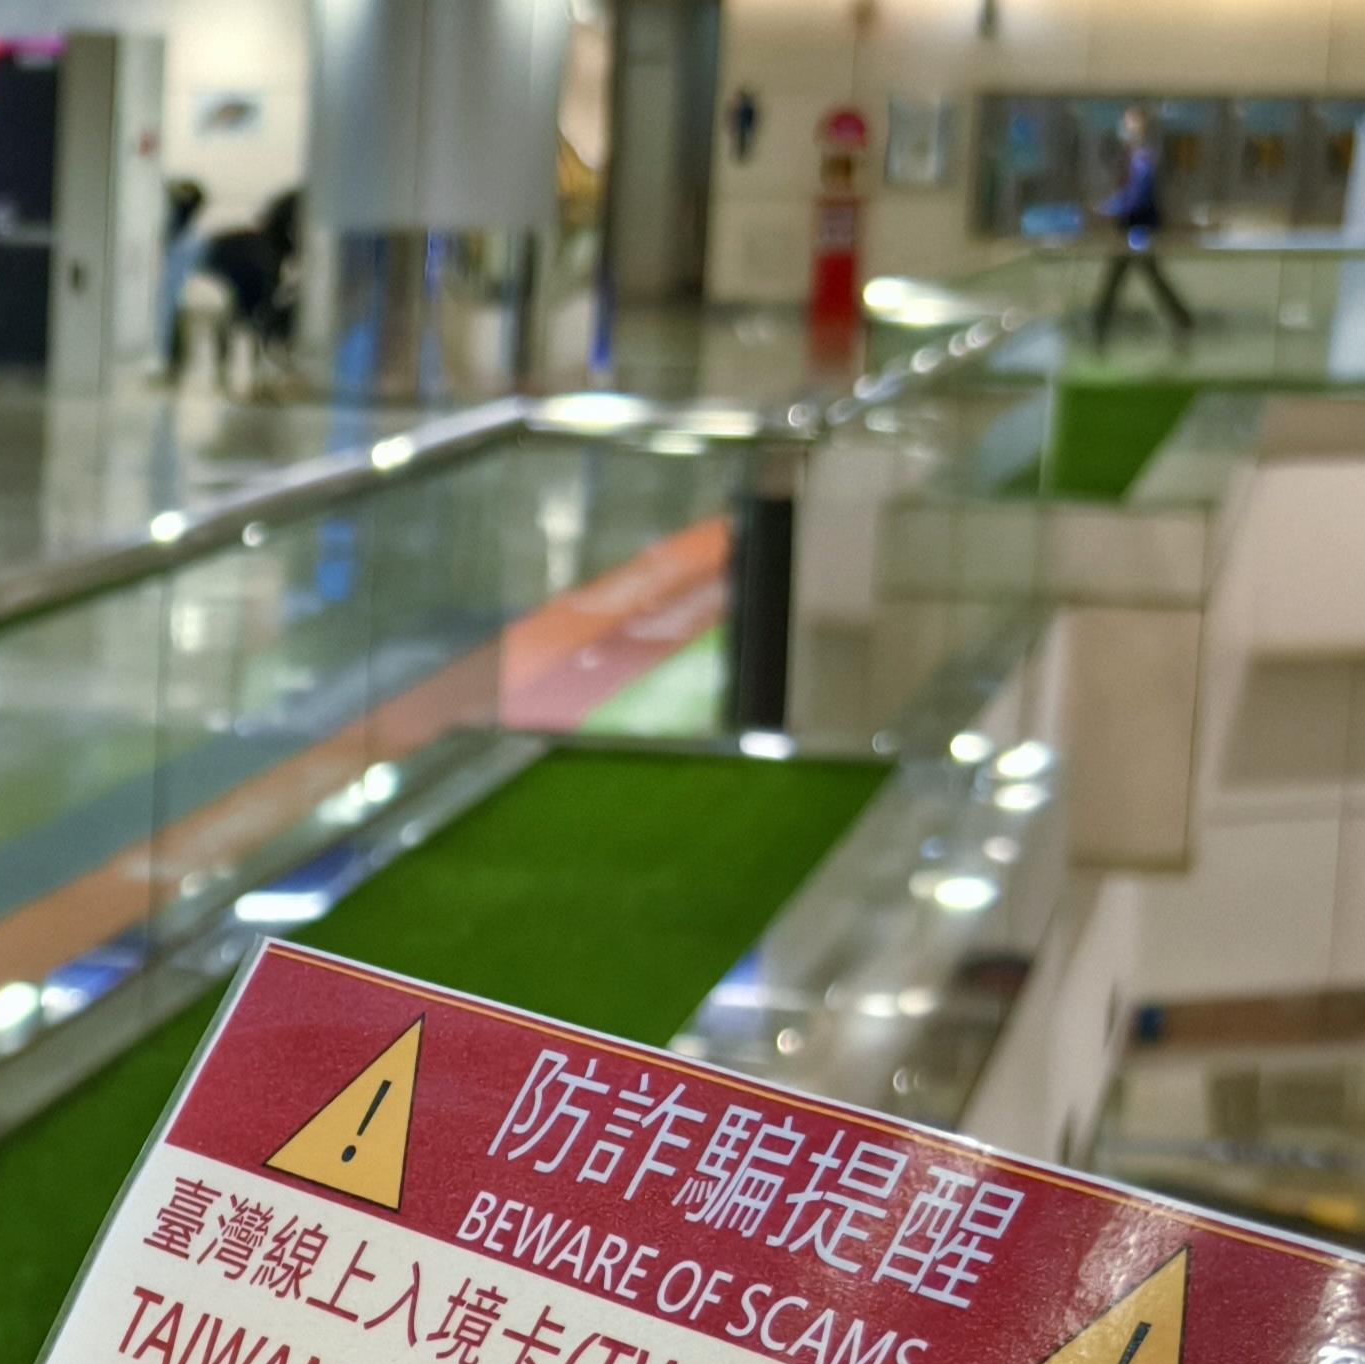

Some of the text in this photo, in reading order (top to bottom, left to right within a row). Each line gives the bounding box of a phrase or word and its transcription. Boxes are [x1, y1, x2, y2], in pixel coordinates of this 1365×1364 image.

[456, 1191, 660, 1302] BEWARE
[656, 1258, 733, 1323] OF
[487, 1048, 1025, 1309] 防詐騙提醒
